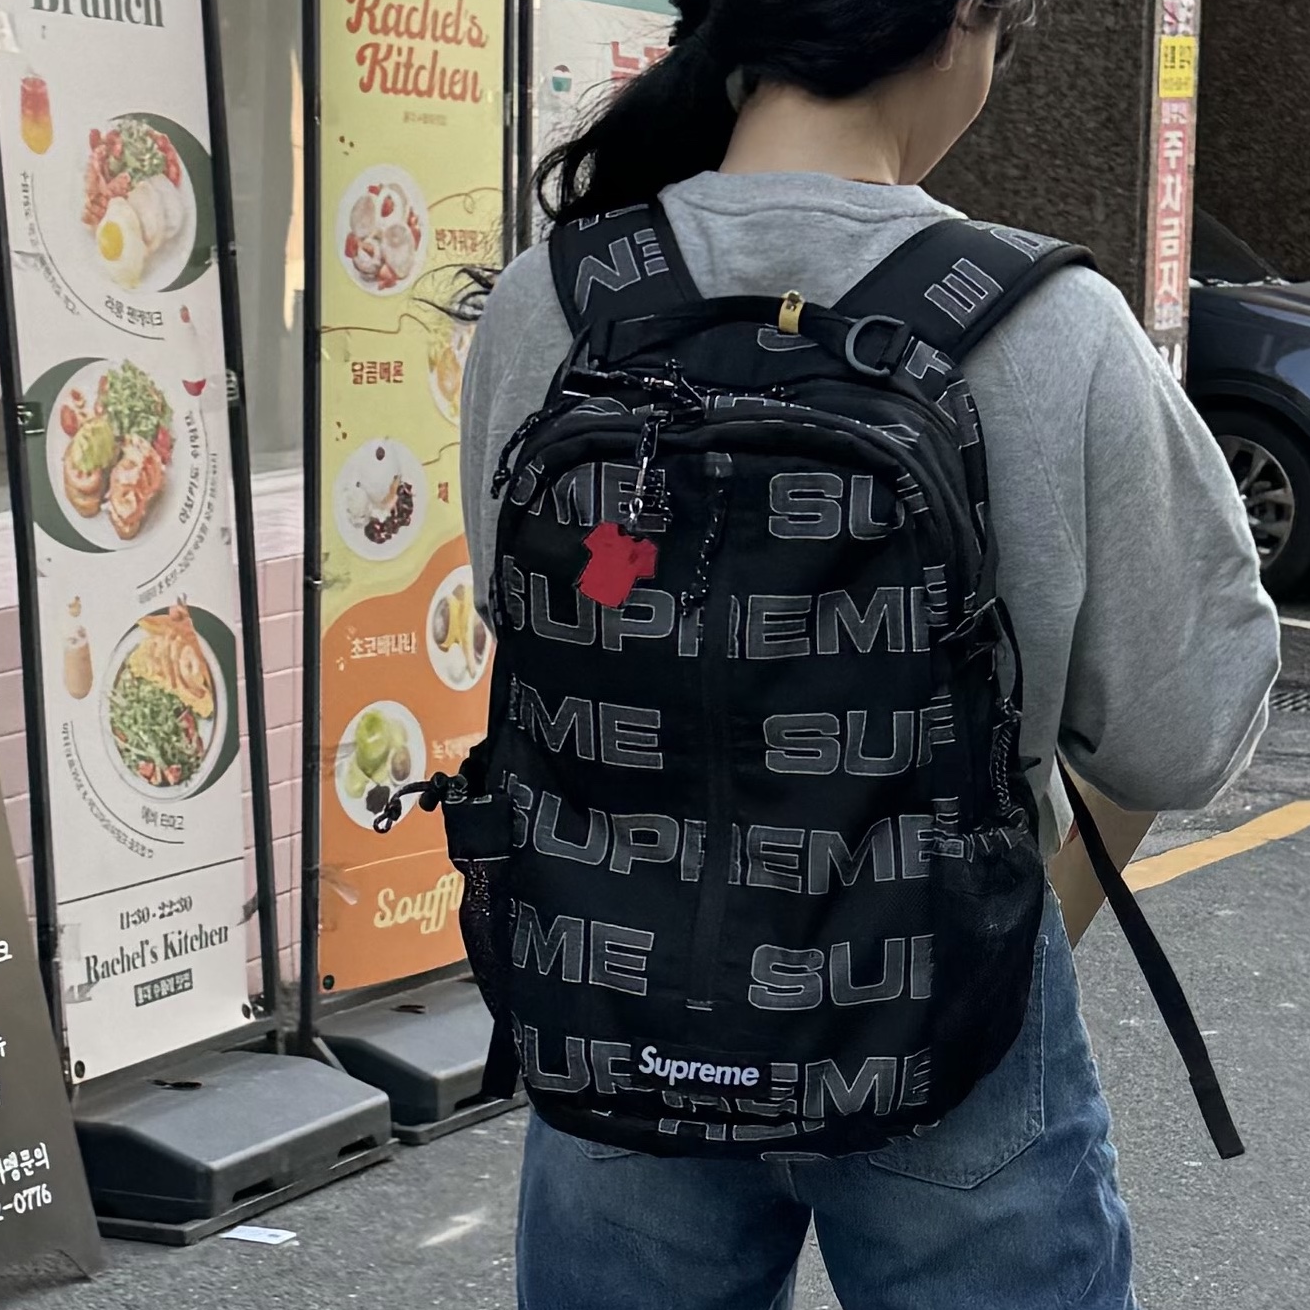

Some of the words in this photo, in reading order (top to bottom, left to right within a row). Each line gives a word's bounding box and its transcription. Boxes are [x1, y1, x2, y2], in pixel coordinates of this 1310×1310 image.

[355, 41, 484, 104] Kitchen
[373, 870, 465, 935] Souffl
[84, 939, 159, 985] Rachel's
[162, 923, 230, 961] Kitchen
[637, 1044, 761, 1088] Supreme
